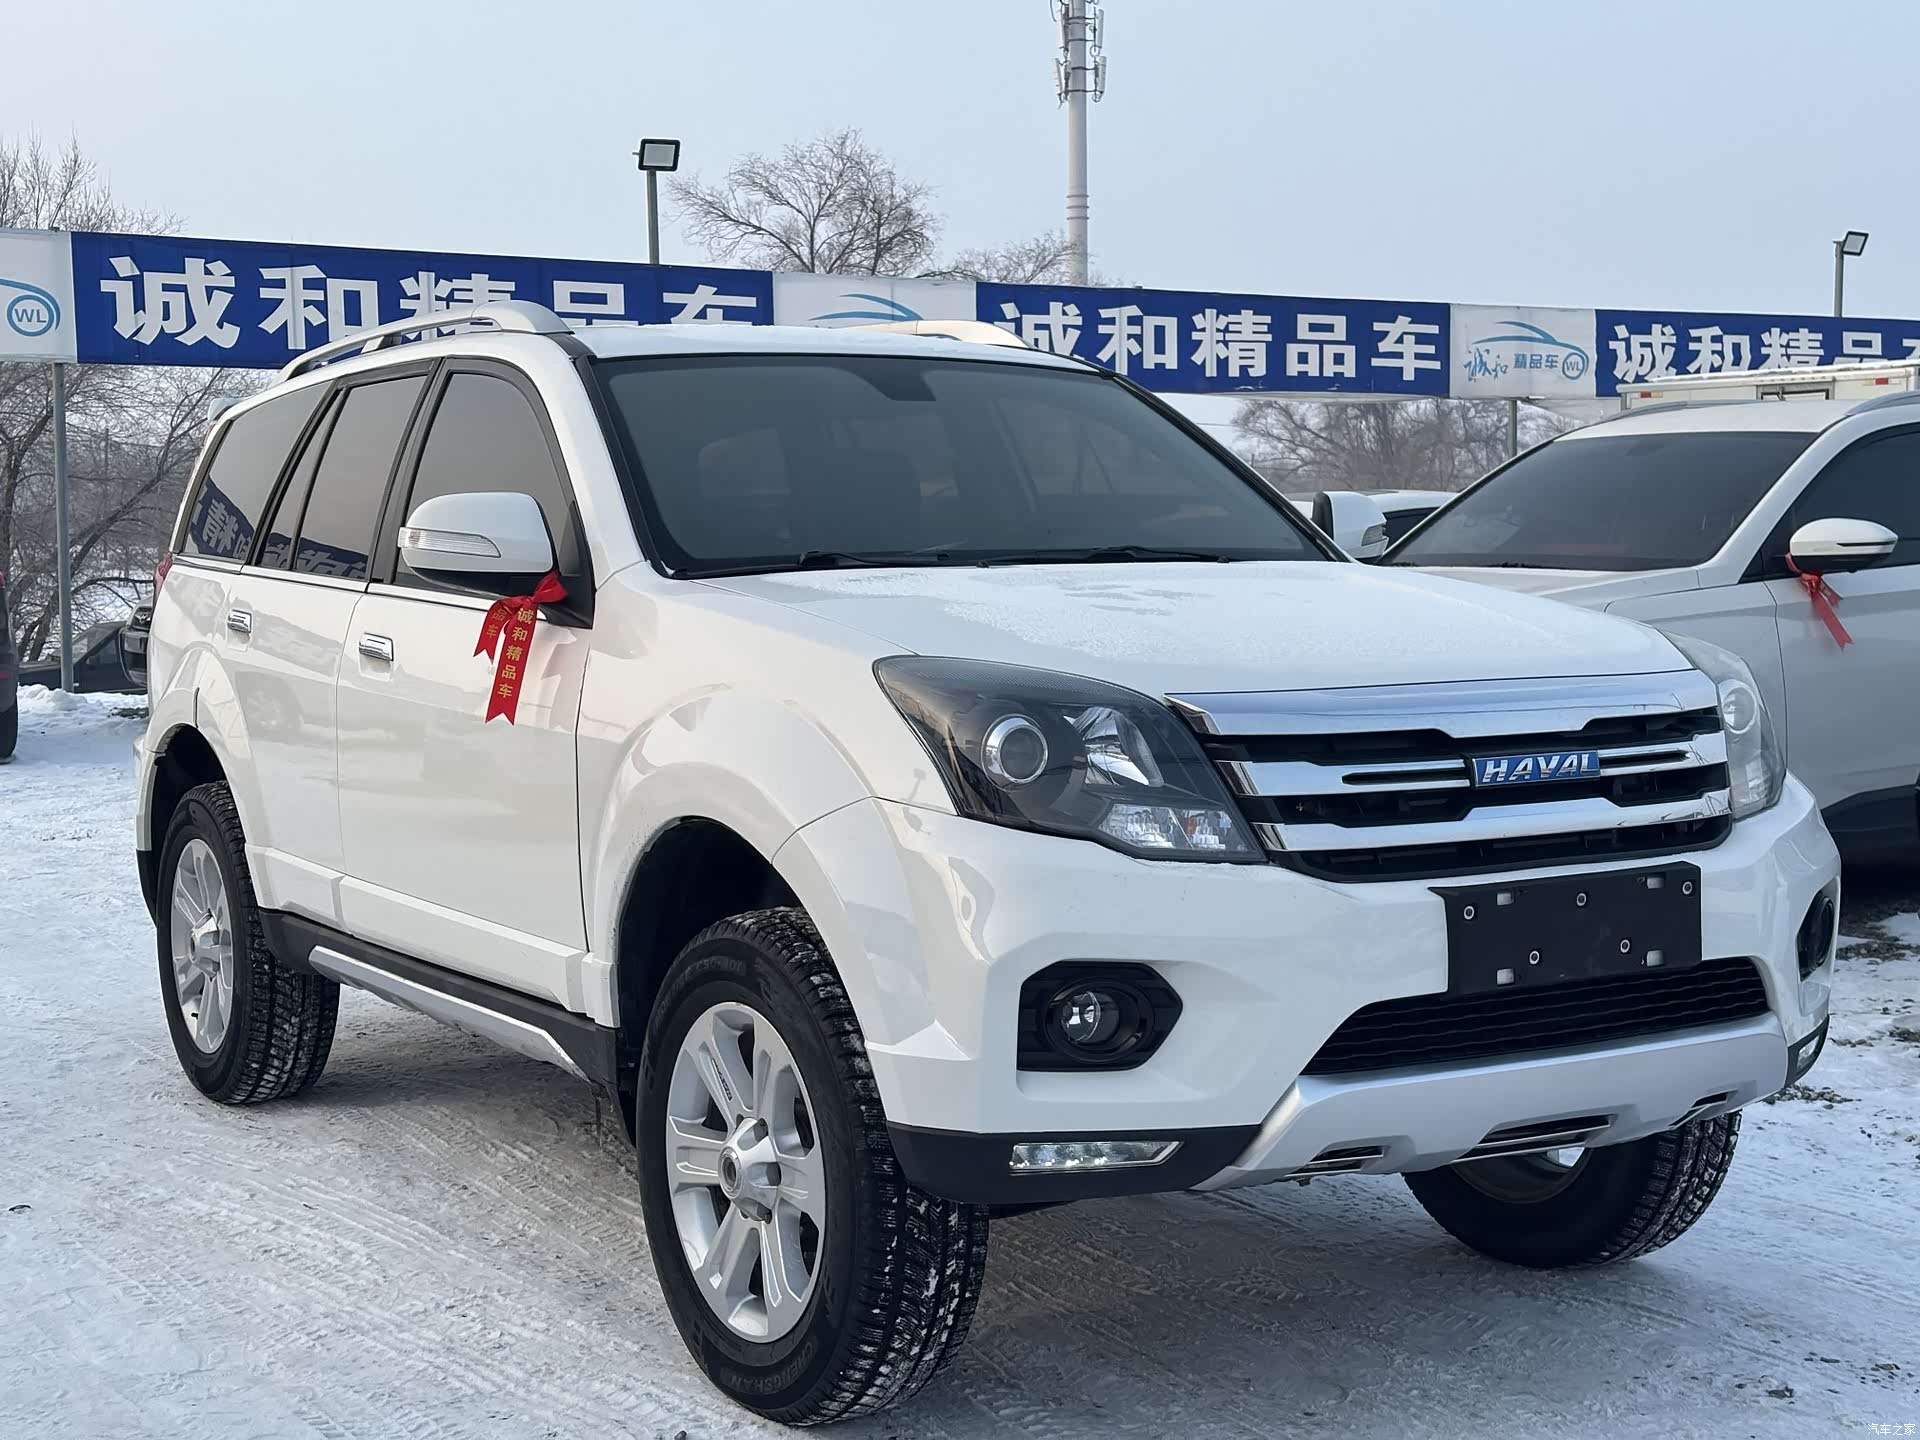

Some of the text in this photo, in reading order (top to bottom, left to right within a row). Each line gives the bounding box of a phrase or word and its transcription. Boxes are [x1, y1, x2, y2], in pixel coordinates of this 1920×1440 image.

[14, 308, 47, 323] WL
[994, 301, 1442, 381] 诚和精品车
[1565, 360, 1584, 372] WL
[498, 607, 535, 699] 诚和精品车
[1482, 753, 1598, 783] HAVAL
